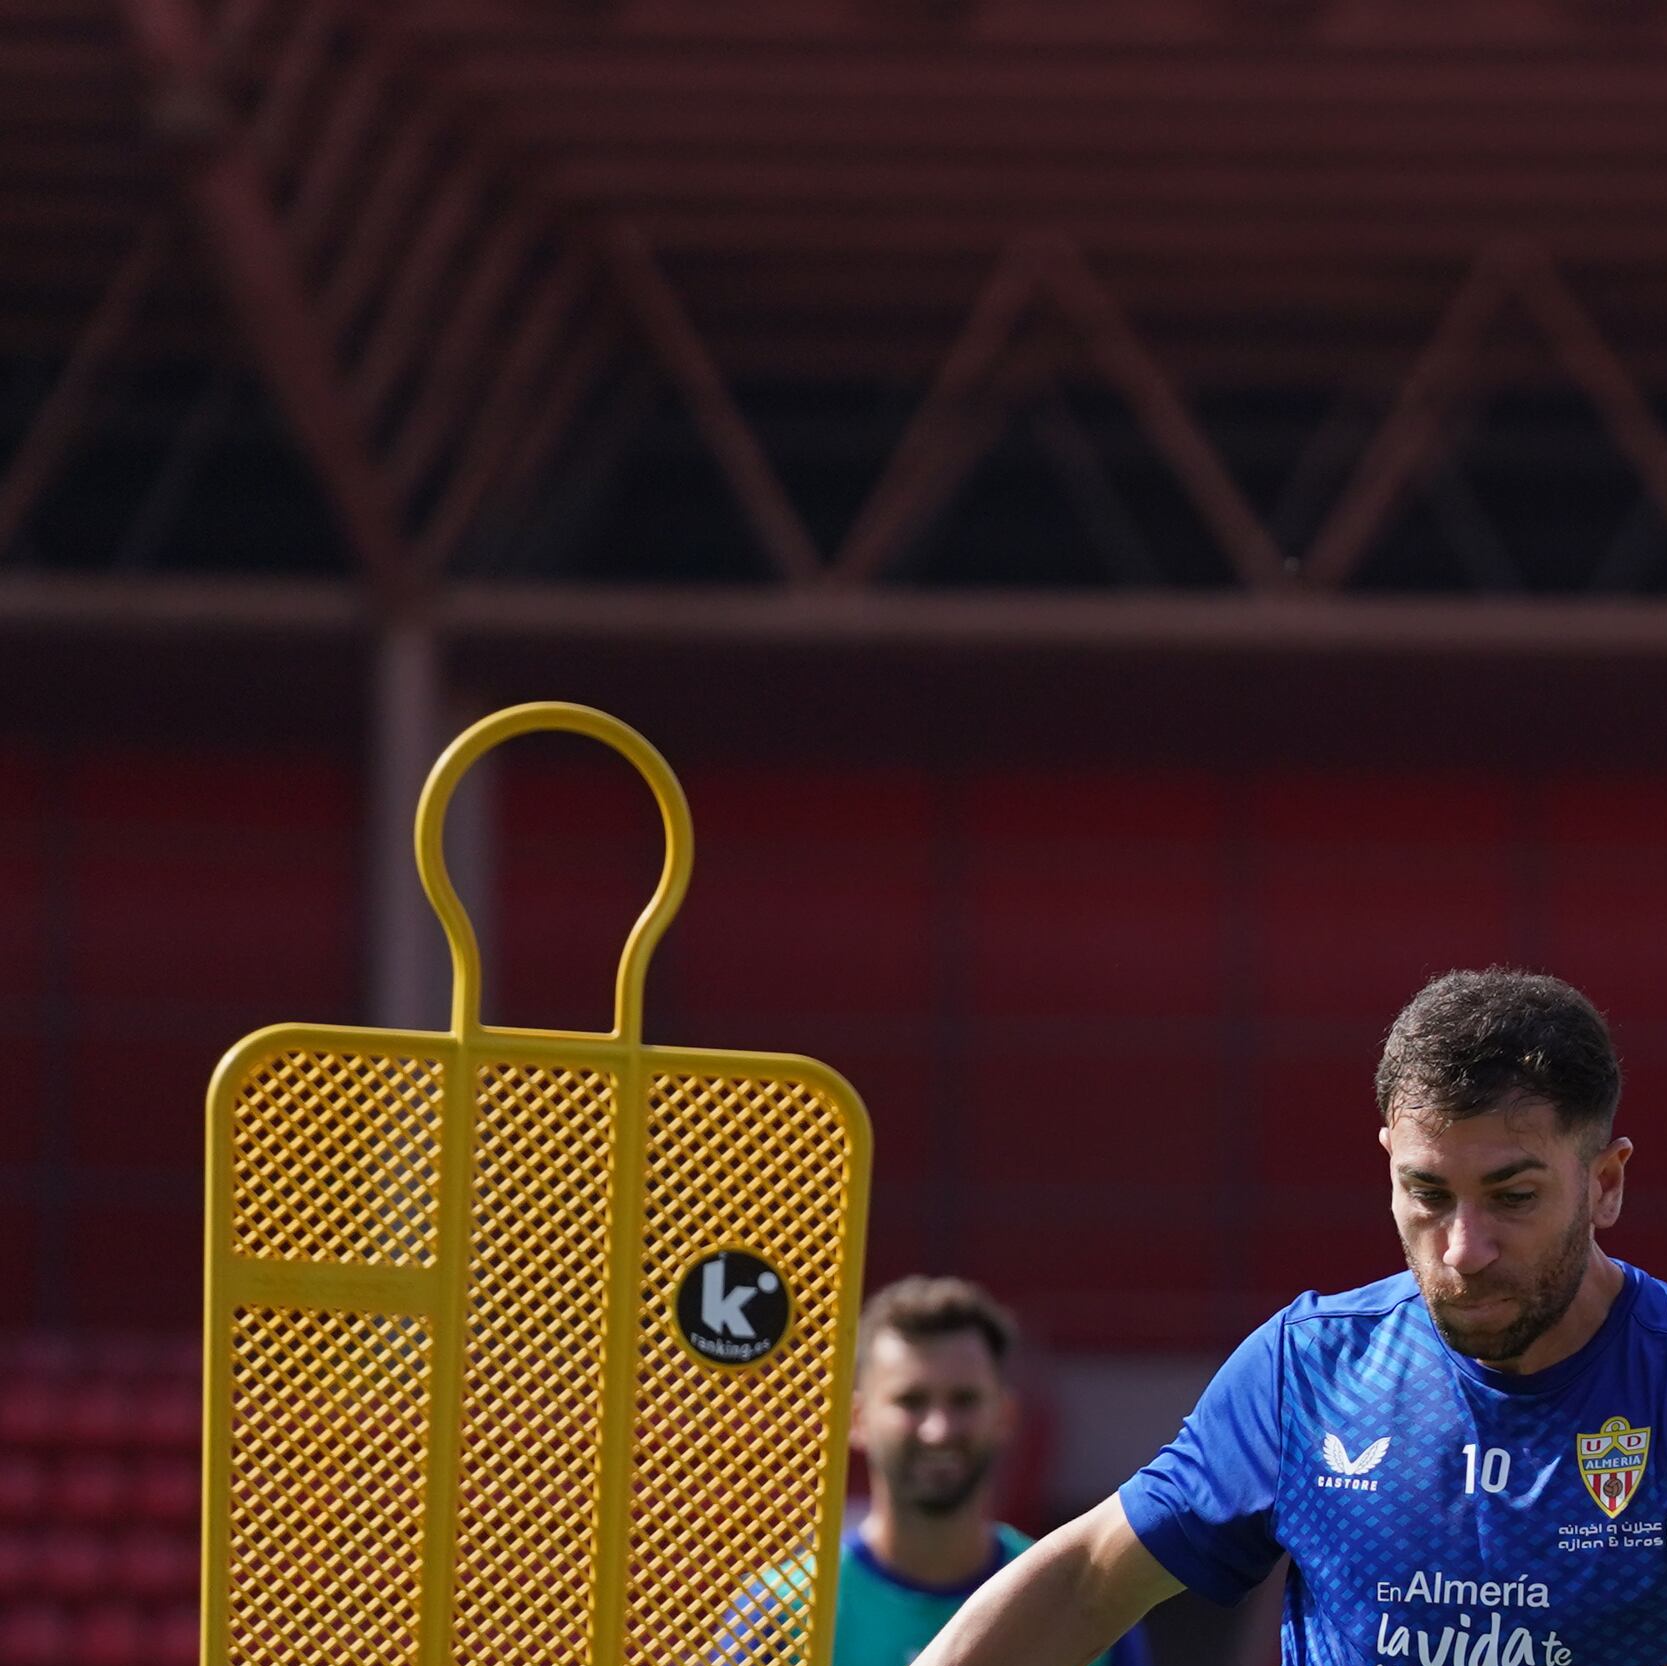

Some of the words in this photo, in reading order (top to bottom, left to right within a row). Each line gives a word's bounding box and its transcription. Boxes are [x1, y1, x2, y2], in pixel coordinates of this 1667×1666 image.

[1586, 1440, 1601, 1452] U
[1626, 1435, 1641, 1448] D
[1462, 1443, 1511, 1494] 10
[1585, 1454, 1641, 1470] ALMERIA
[1317, 1475, 1378, 1492] CASTORE
[1558, 1538, 1604, 1552] ajlan
[1608, 1537, 1619, 1547] &
[1624, 1537, 1664, 1547] bros
[1377, 1581, 1401, 1602] En
[1403, 1571, 1550, 1607] Almería
[1377, 1612, 1410, 1656] la
